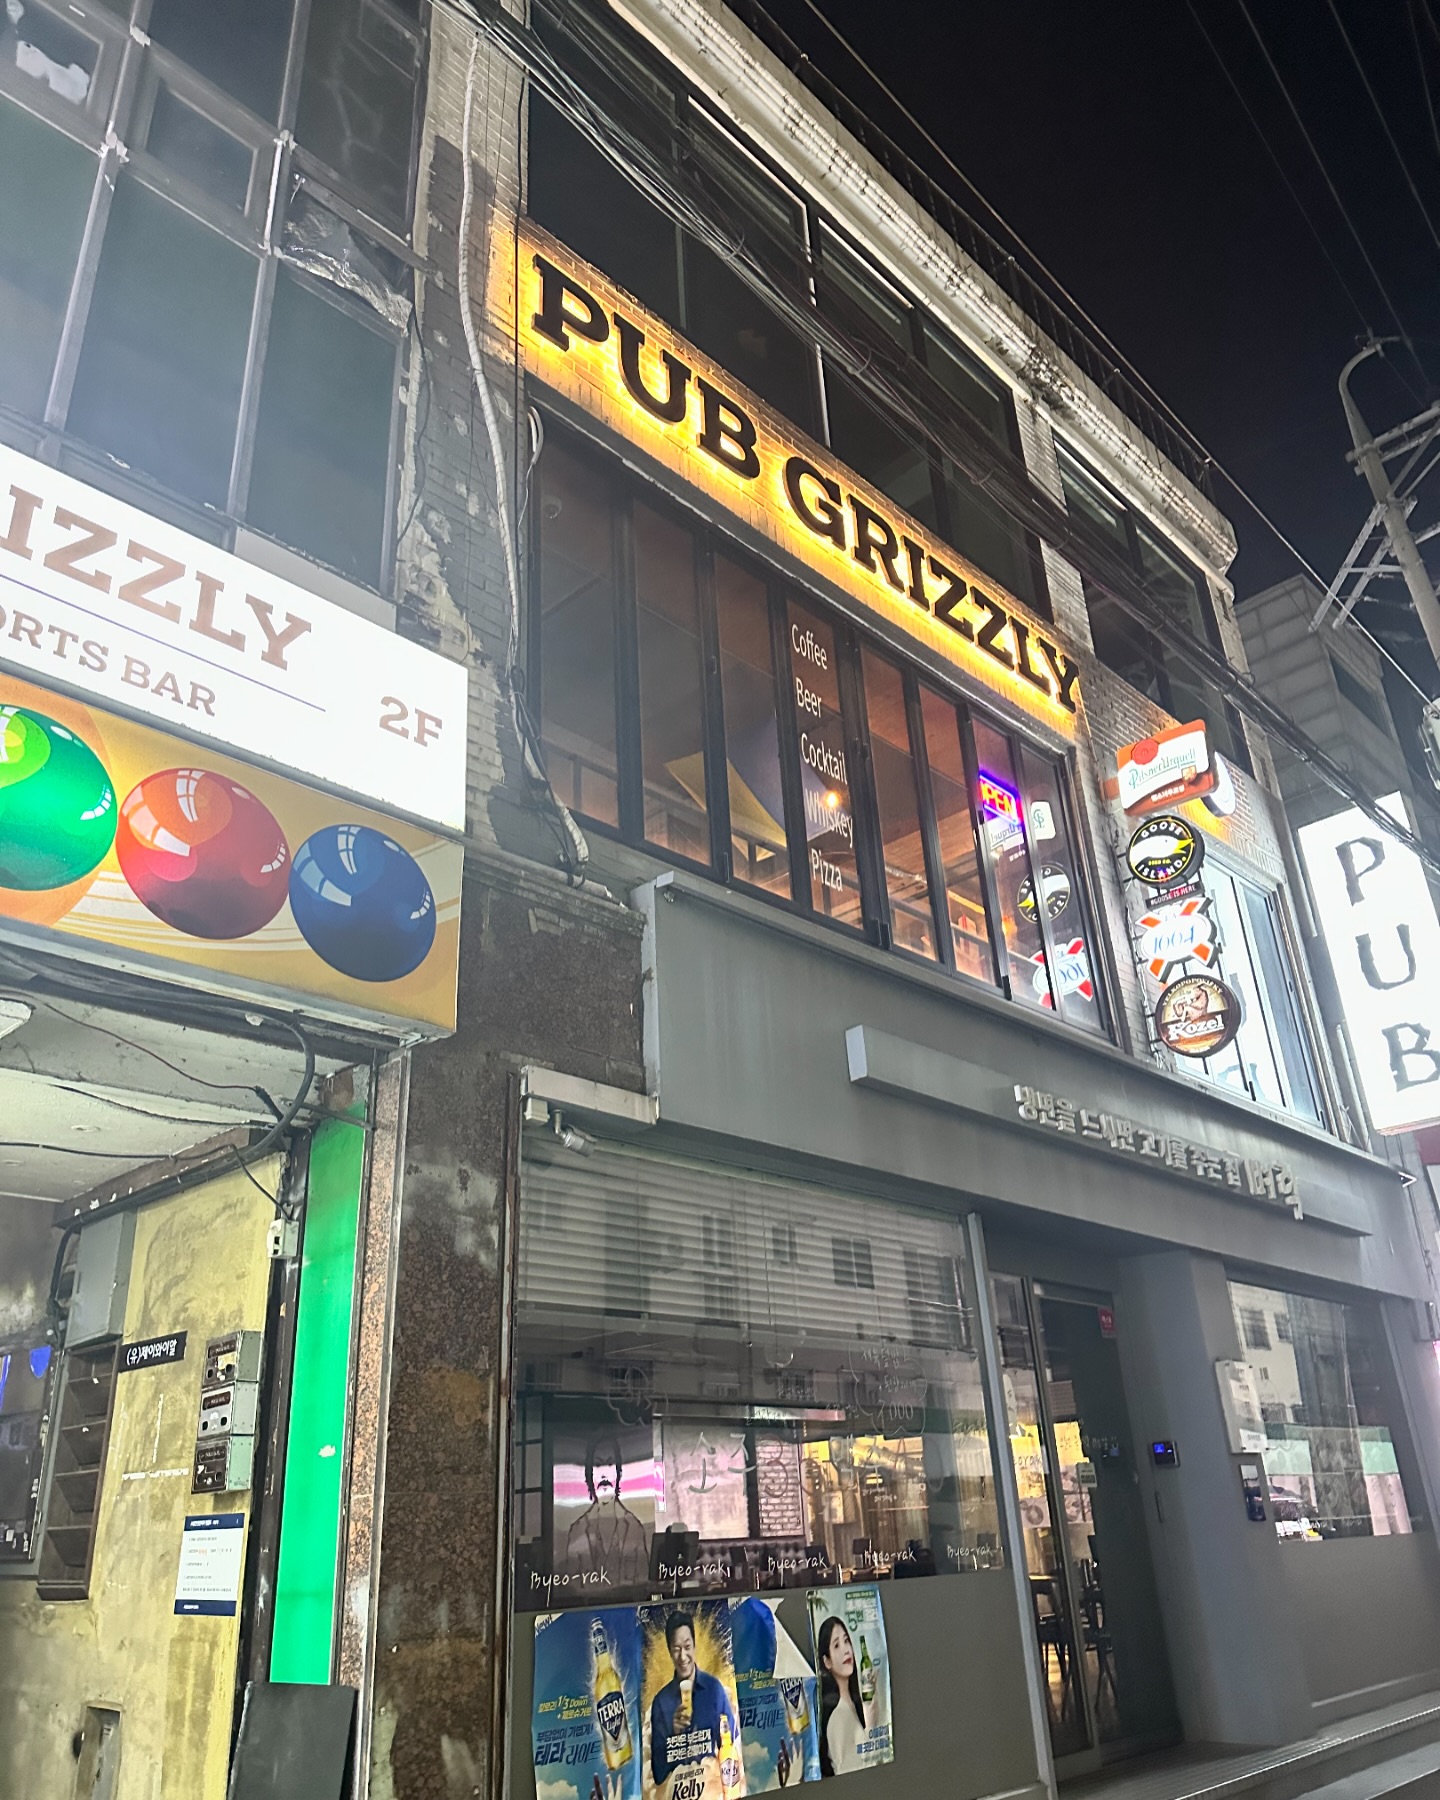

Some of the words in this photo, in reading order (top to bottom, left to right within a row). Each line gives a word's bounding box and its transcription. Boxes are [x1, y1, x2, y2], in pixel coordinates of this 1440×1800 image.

[531, 253, 761, 481] PUB
[782, 456, 1080, 715] GRIZZLY
[791, 623, 828, 670] Coffee
[121, 654, 217, 717] BAR
[795, 676, 822, 718] Beer
[379, 695, 443, 748] 2F
[801, 732, 848, 785] Cocktail
[805, 788, 854, 848] Whiskey
[1140, 821, 1184, 838] GOOSE
[811, 848, 843, 892] Pizza
[1137, 859, 1183, 879] ISLAND
[1173, 890, 1181, 898] IS
[1180, 884, 1197, 896] HERE
[1335, 835, 1440, 1093] PUB
[1168, 1013, 1225, 1042] Kozel
[1137, 1128, 1189, 1171] 고기를
[529, 1564, 612, 1607] Byeo-rak
[767, 1551, 829, 1588] Byeo-rak
[557, 1695, 570, 1711] 1/3
[597, 1697, 625, 1724] TERRA
[537, 1726, 568, 1743] 부담없이
[606, 1716, 621, 1734] Light
[666, 1733, 687, 1749] 첫맛은
[535, 1740, 567, 1766] 테라
[565, 1739, 602, 1767] 라이트
[671, 1777, 706, 1800] Kelly
